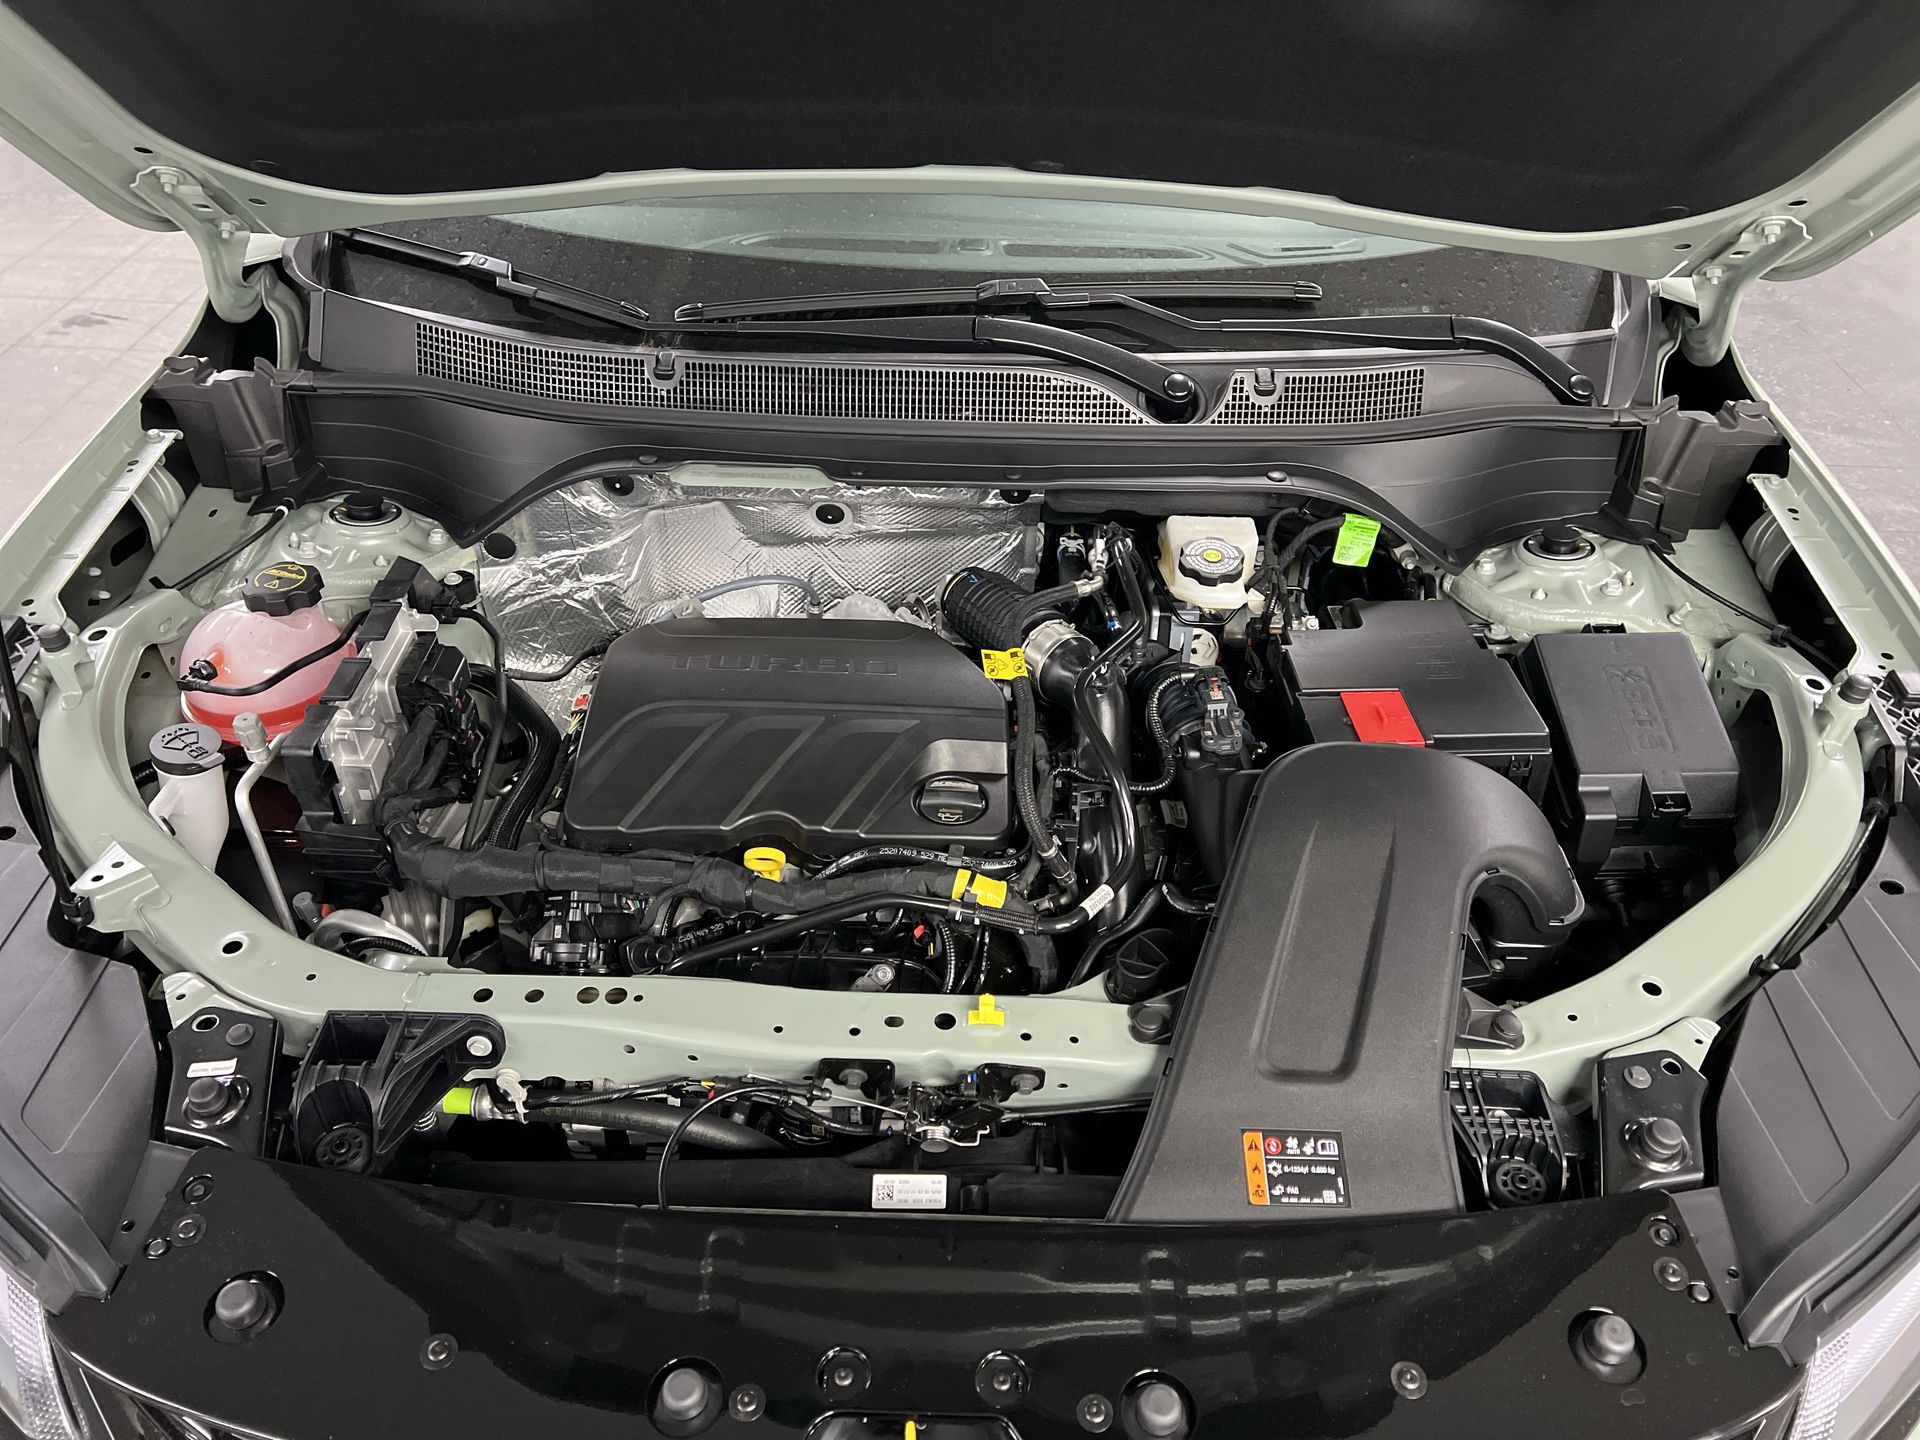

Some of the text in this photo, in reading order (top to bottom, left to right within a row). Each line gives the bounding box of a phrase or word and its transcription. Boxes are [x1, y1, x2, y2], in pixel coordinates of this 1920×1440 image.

[664, 654, 899, 677] TURBO
[879, 847, 918, 858] 25207409
[920, 851, 935, 861] 529
